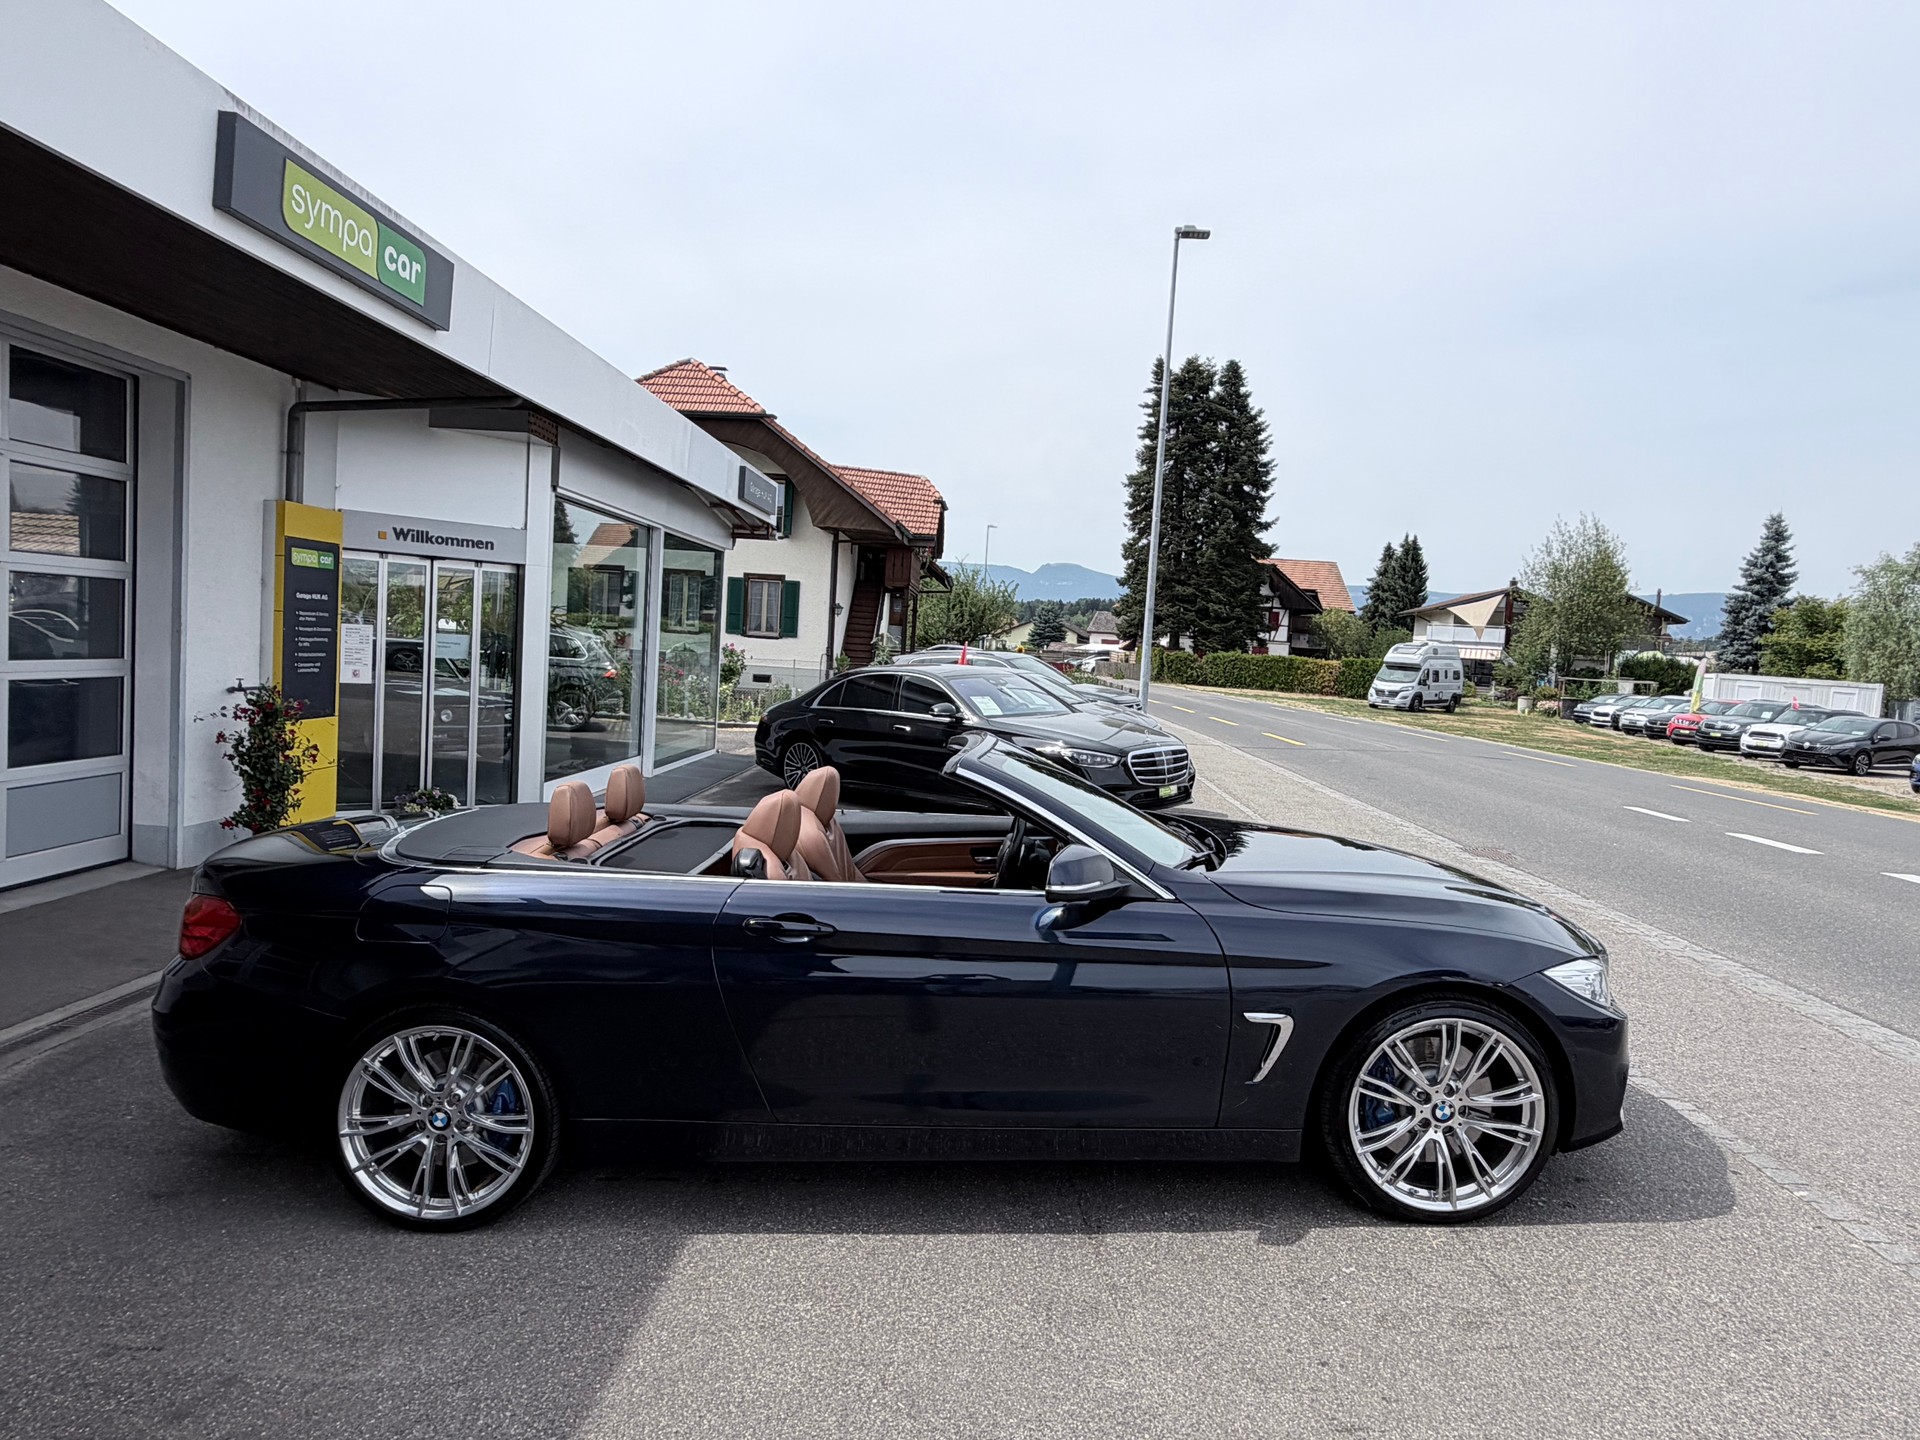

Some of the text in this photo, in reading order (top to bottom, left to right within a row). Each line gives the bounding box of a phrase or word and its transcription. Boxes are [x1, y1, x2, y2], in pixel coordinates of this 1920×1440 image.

[291, 184, 421, 284] sympa car
[391, 526, 495, 551] Willkommen
[292, 552, 333, 564] sympa car
